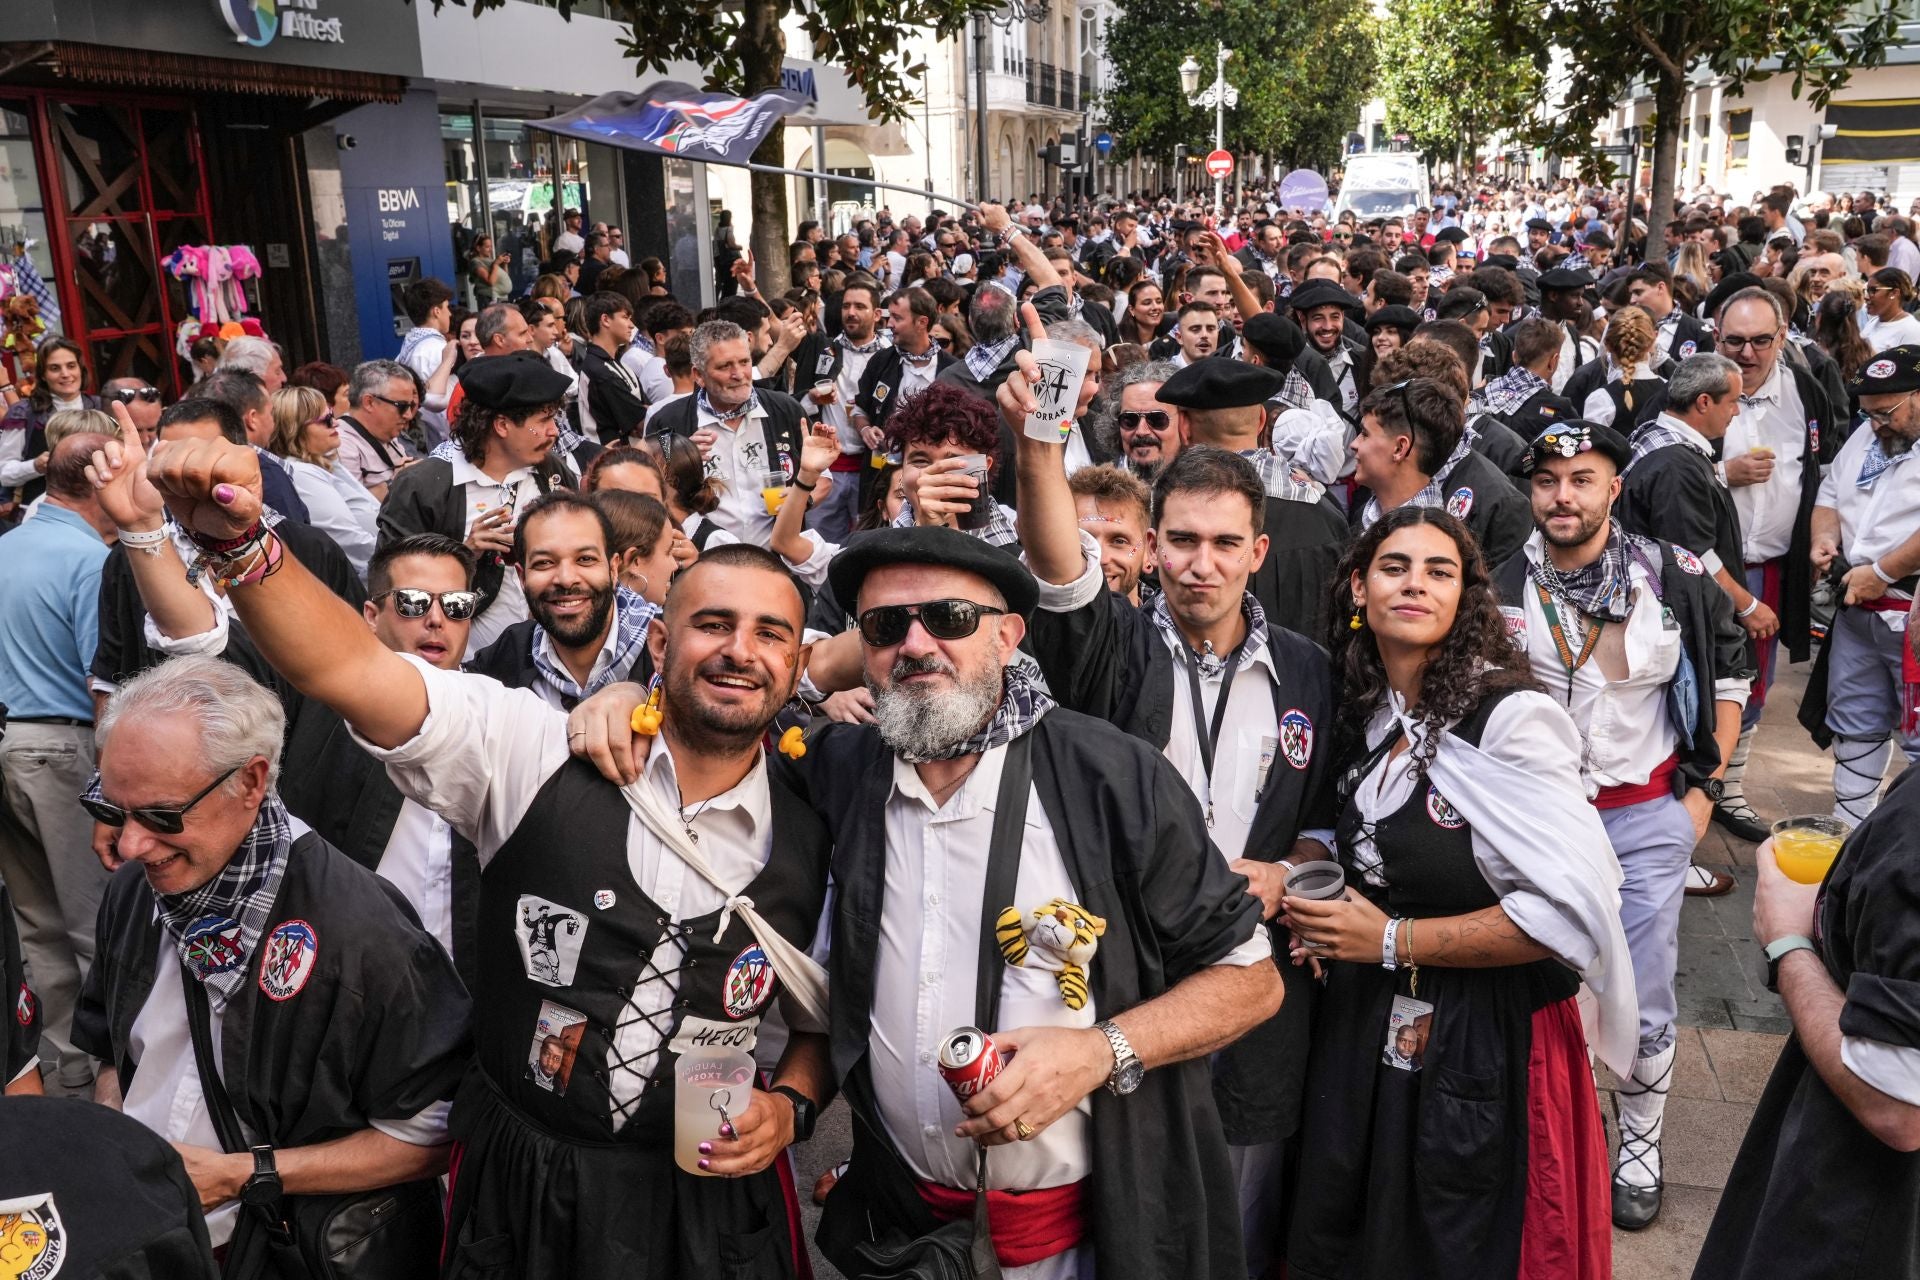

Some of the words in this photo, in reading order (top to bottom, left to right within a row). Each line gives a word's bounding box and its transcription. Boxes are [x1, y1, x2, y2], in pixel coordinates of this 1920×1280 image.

[281, 10, 345, 44] Attest
[378, 187, 420, 212] BBVA
[262, 975, 296, 998] JATORRAK
[20, 1239, 62, 1280] GASTEIZ
